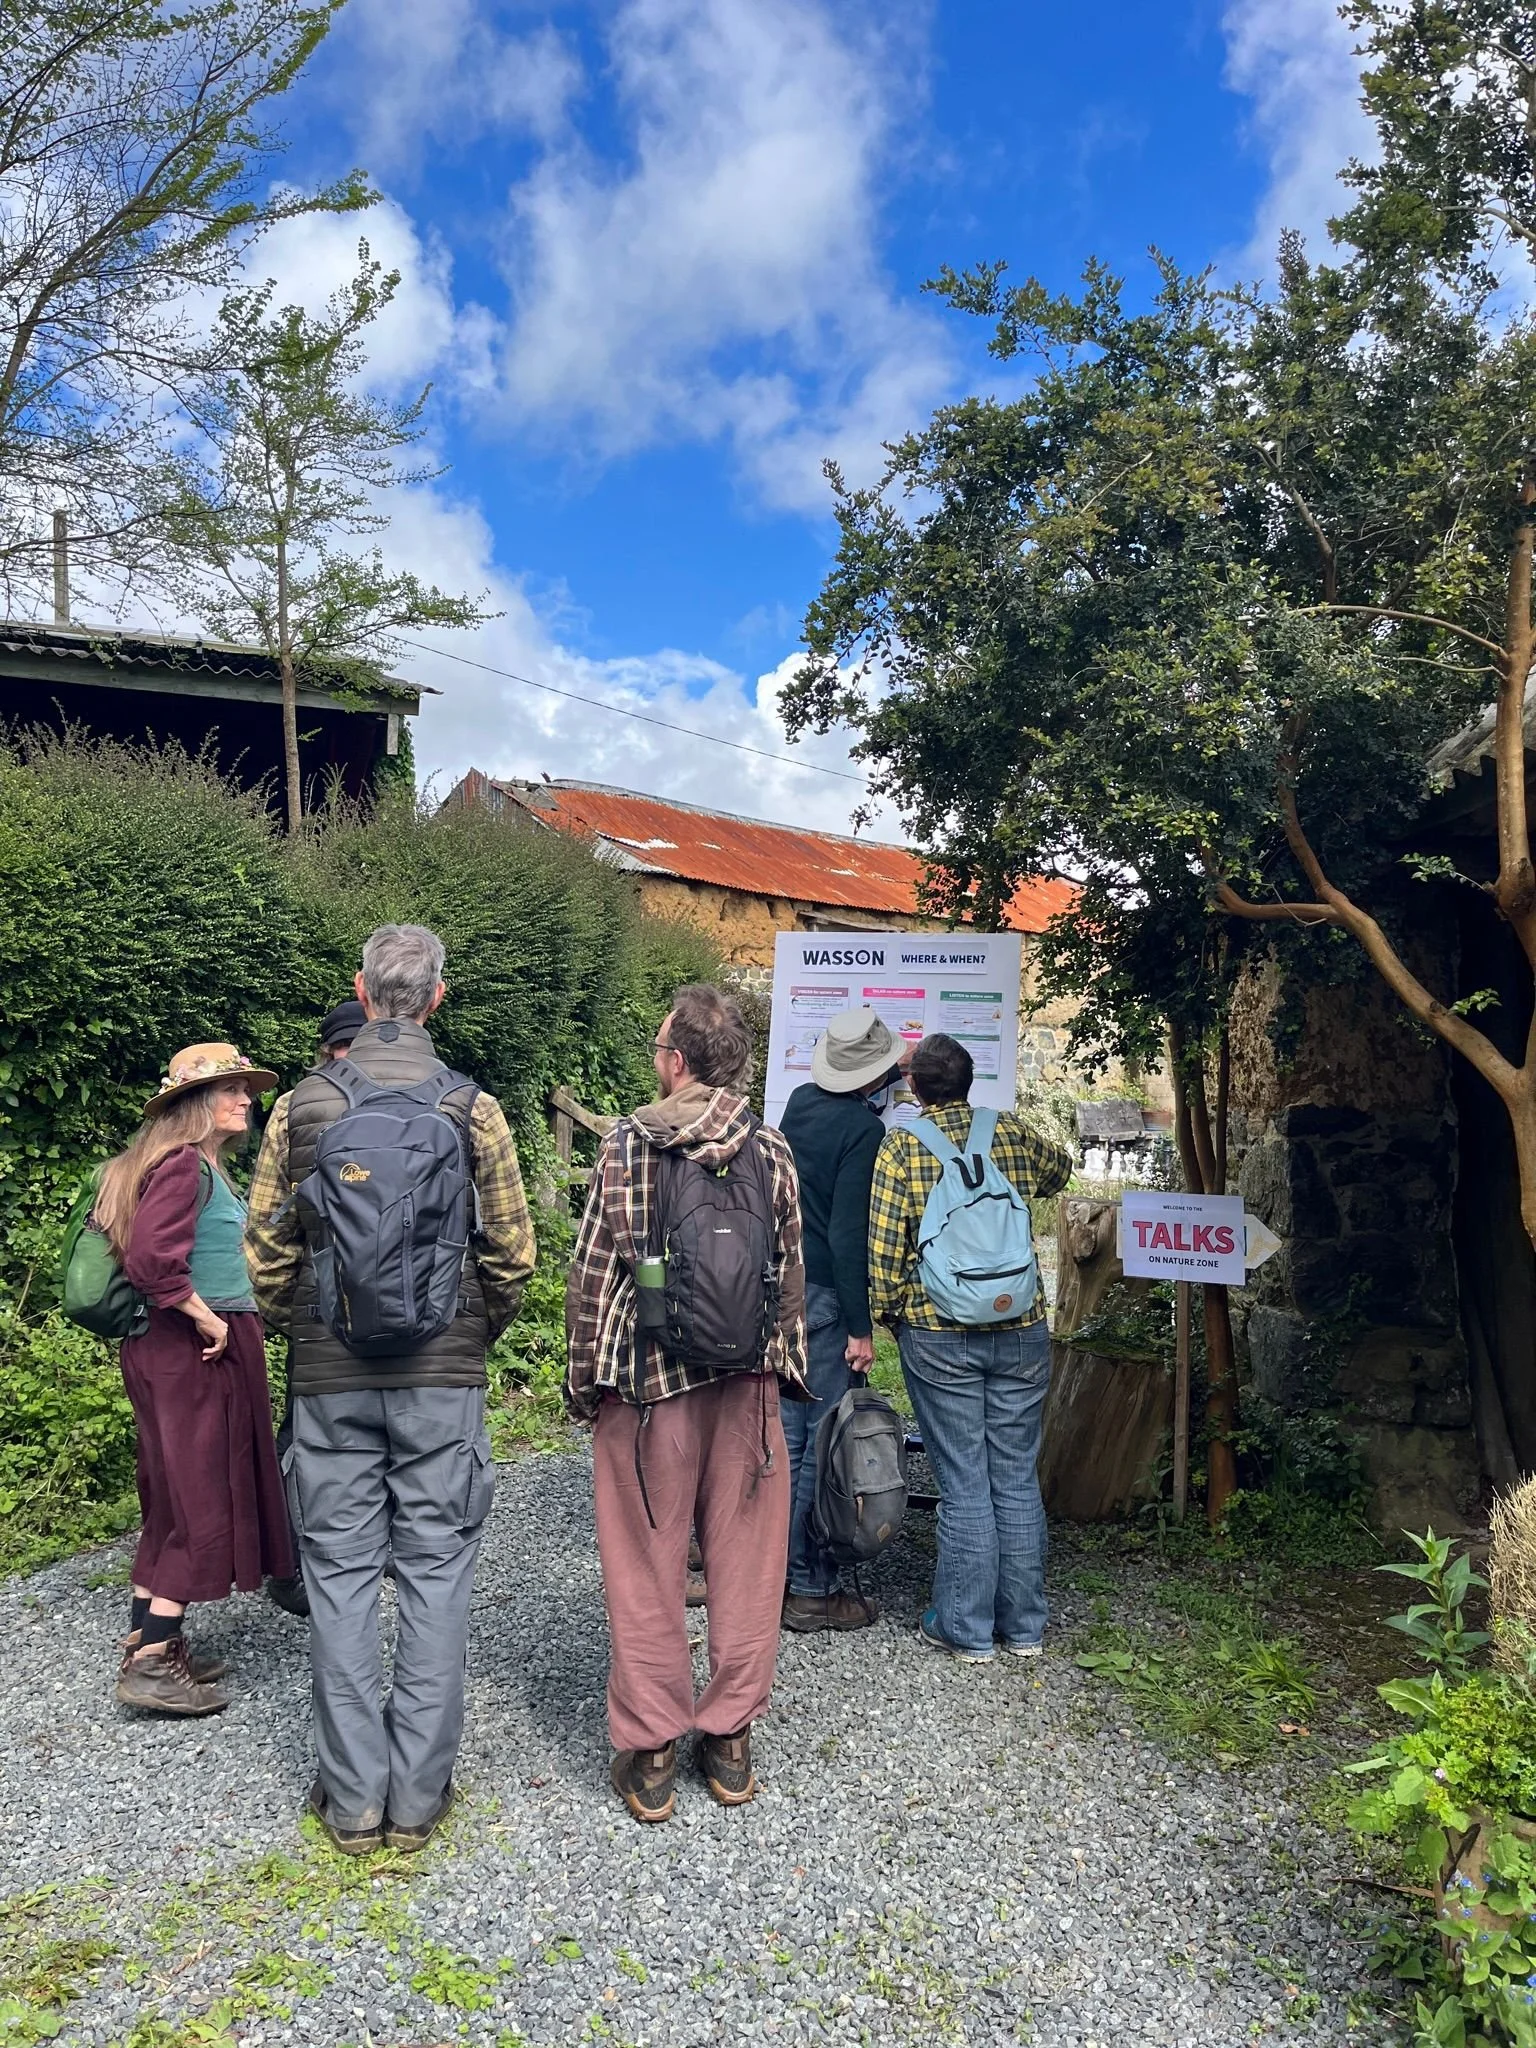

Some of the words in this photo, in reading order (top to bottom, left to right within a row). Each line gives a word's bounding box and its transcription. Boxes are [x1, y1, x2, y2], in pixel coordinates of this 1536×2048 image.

[803, 949, 885, 966] WASSON
[901, 954, 937, 964] WHERE
[939, 955, 948, 964] &
[949, 954, 986, 965] WHEN?
[344, 1174, 367, 1182] alpine
[351, 1169, 371, 1177] Lowe
[1132, 1221, 1235, 1255] TALKS
[1148, 1255, 1161, 1264] ON
[1162, 1256, 1195, 1267] NATURE
[1196, 1259, 1219, 1268] ZONE
